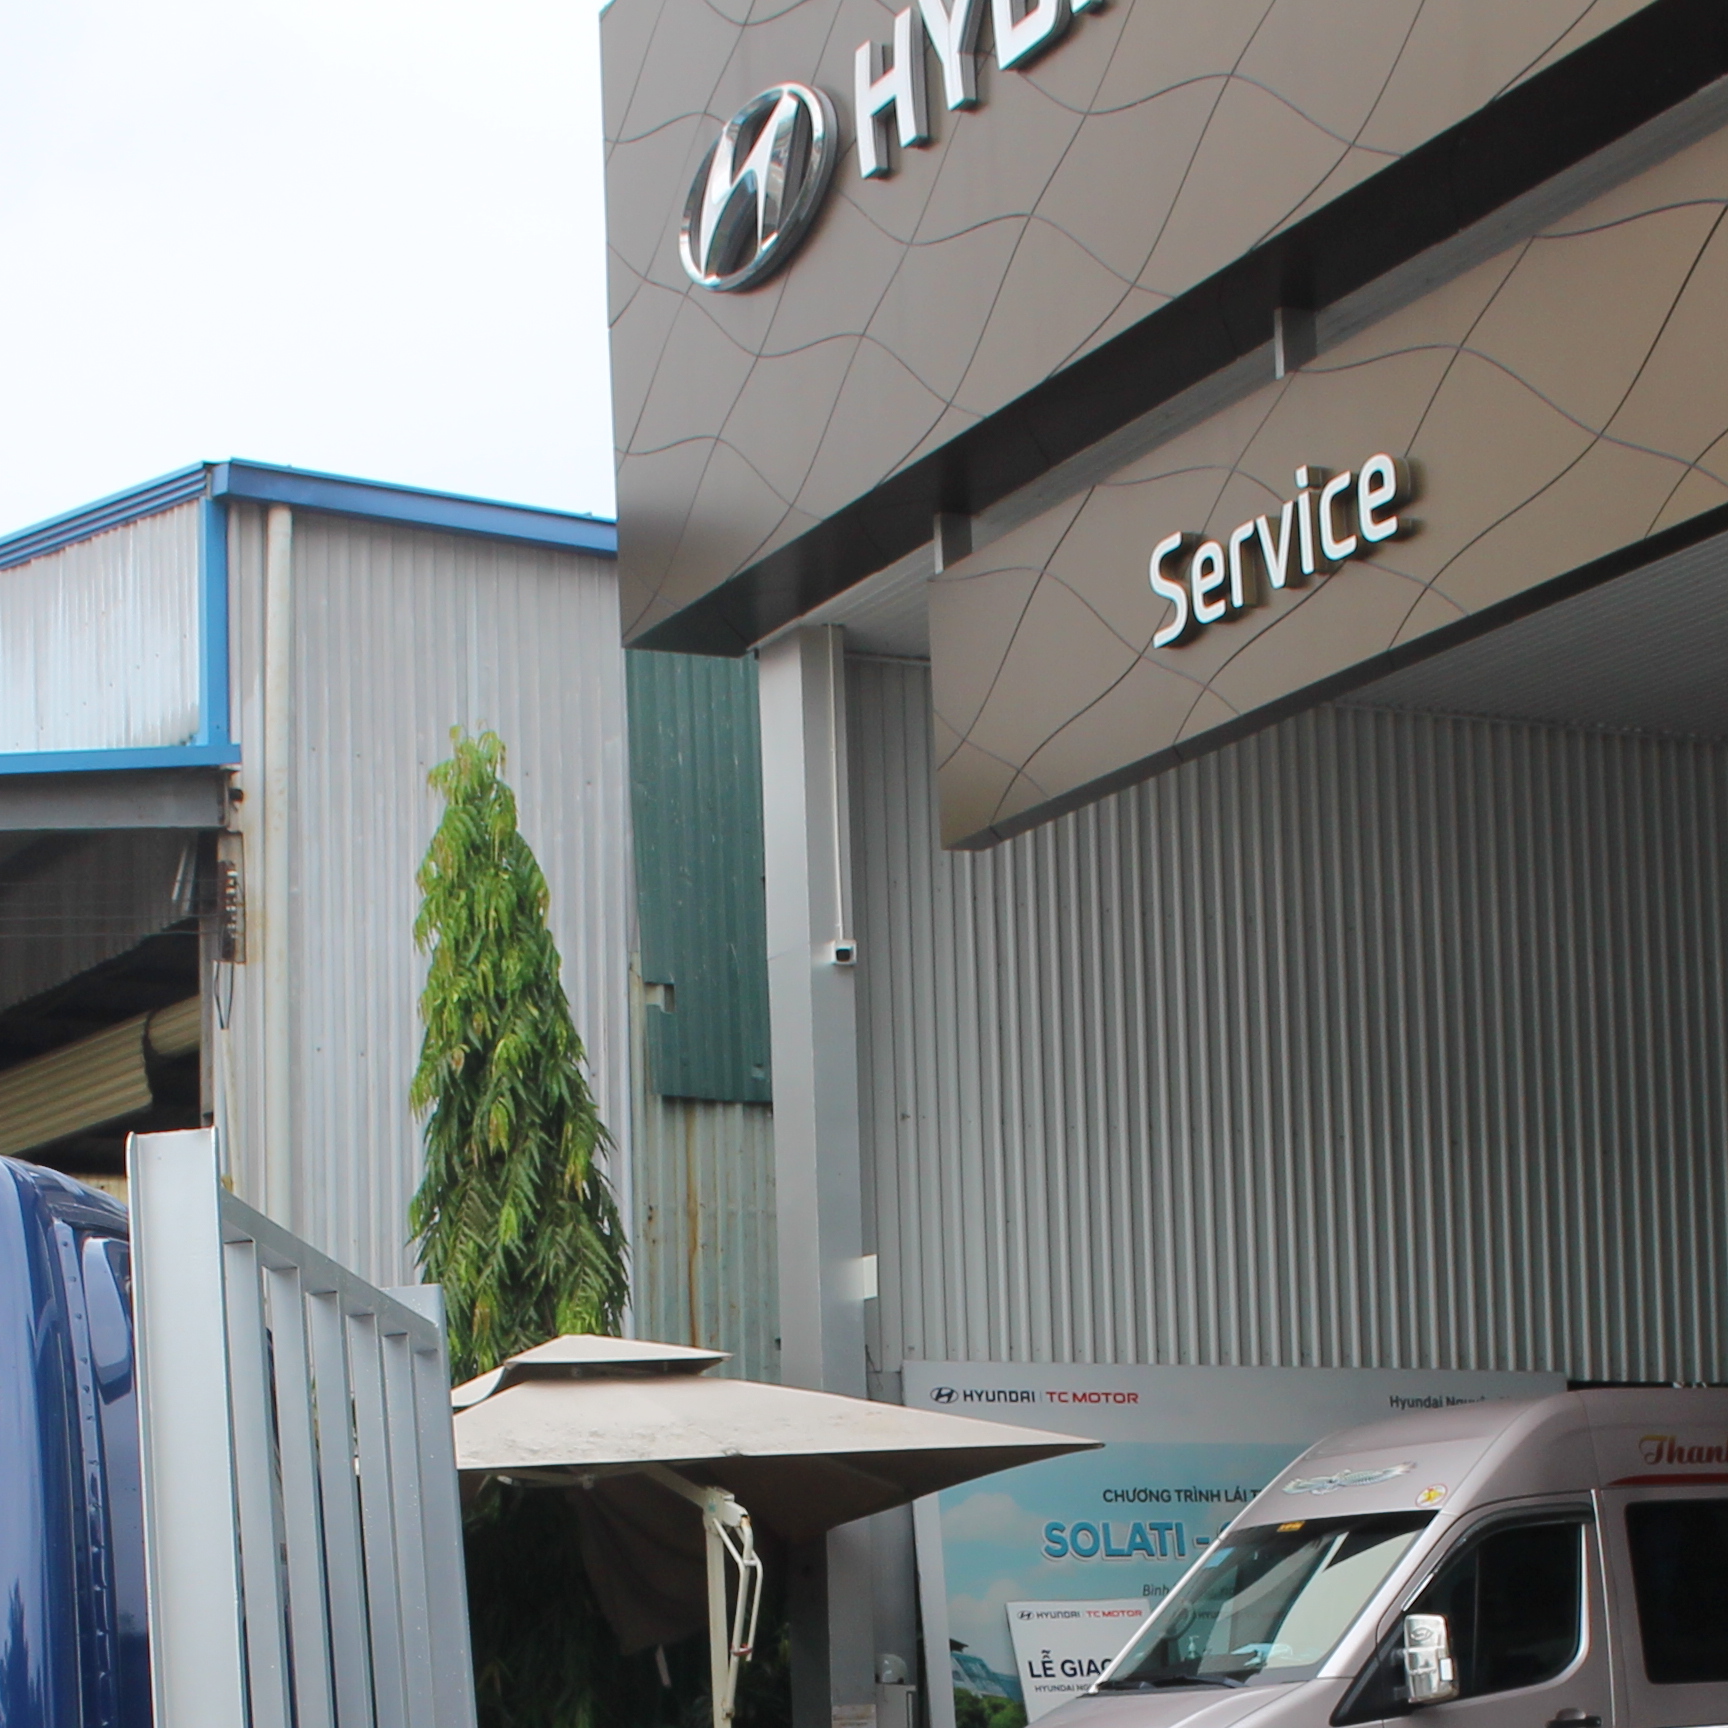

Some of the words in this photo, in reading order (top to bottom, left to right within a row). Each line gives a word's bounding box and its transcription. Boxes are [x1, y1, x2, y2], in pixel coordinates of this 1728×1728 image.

[1149, 451, 1399, 649] Service
[963, 1389, 1035, 1404] HYUNDAI
[1045, 1391, 1069, 1404] TC
[1072, 1391, 1139, 1405] MOTOR
[1389, 1394, 1443, 1411] Hyundai
[1102, 1486, 1172, 1504] CHƯƠNG
[1174, 1484, 1221, 1504] TRÌNH
[1042, 1519, 1188, 1560] SOLATI
[1036, 1610, 1081, 1620] HYUNDAI
[1102, 1609, 1143, 1618] MOTOR
[1027, 1648, 1056, 1679] LỄ
